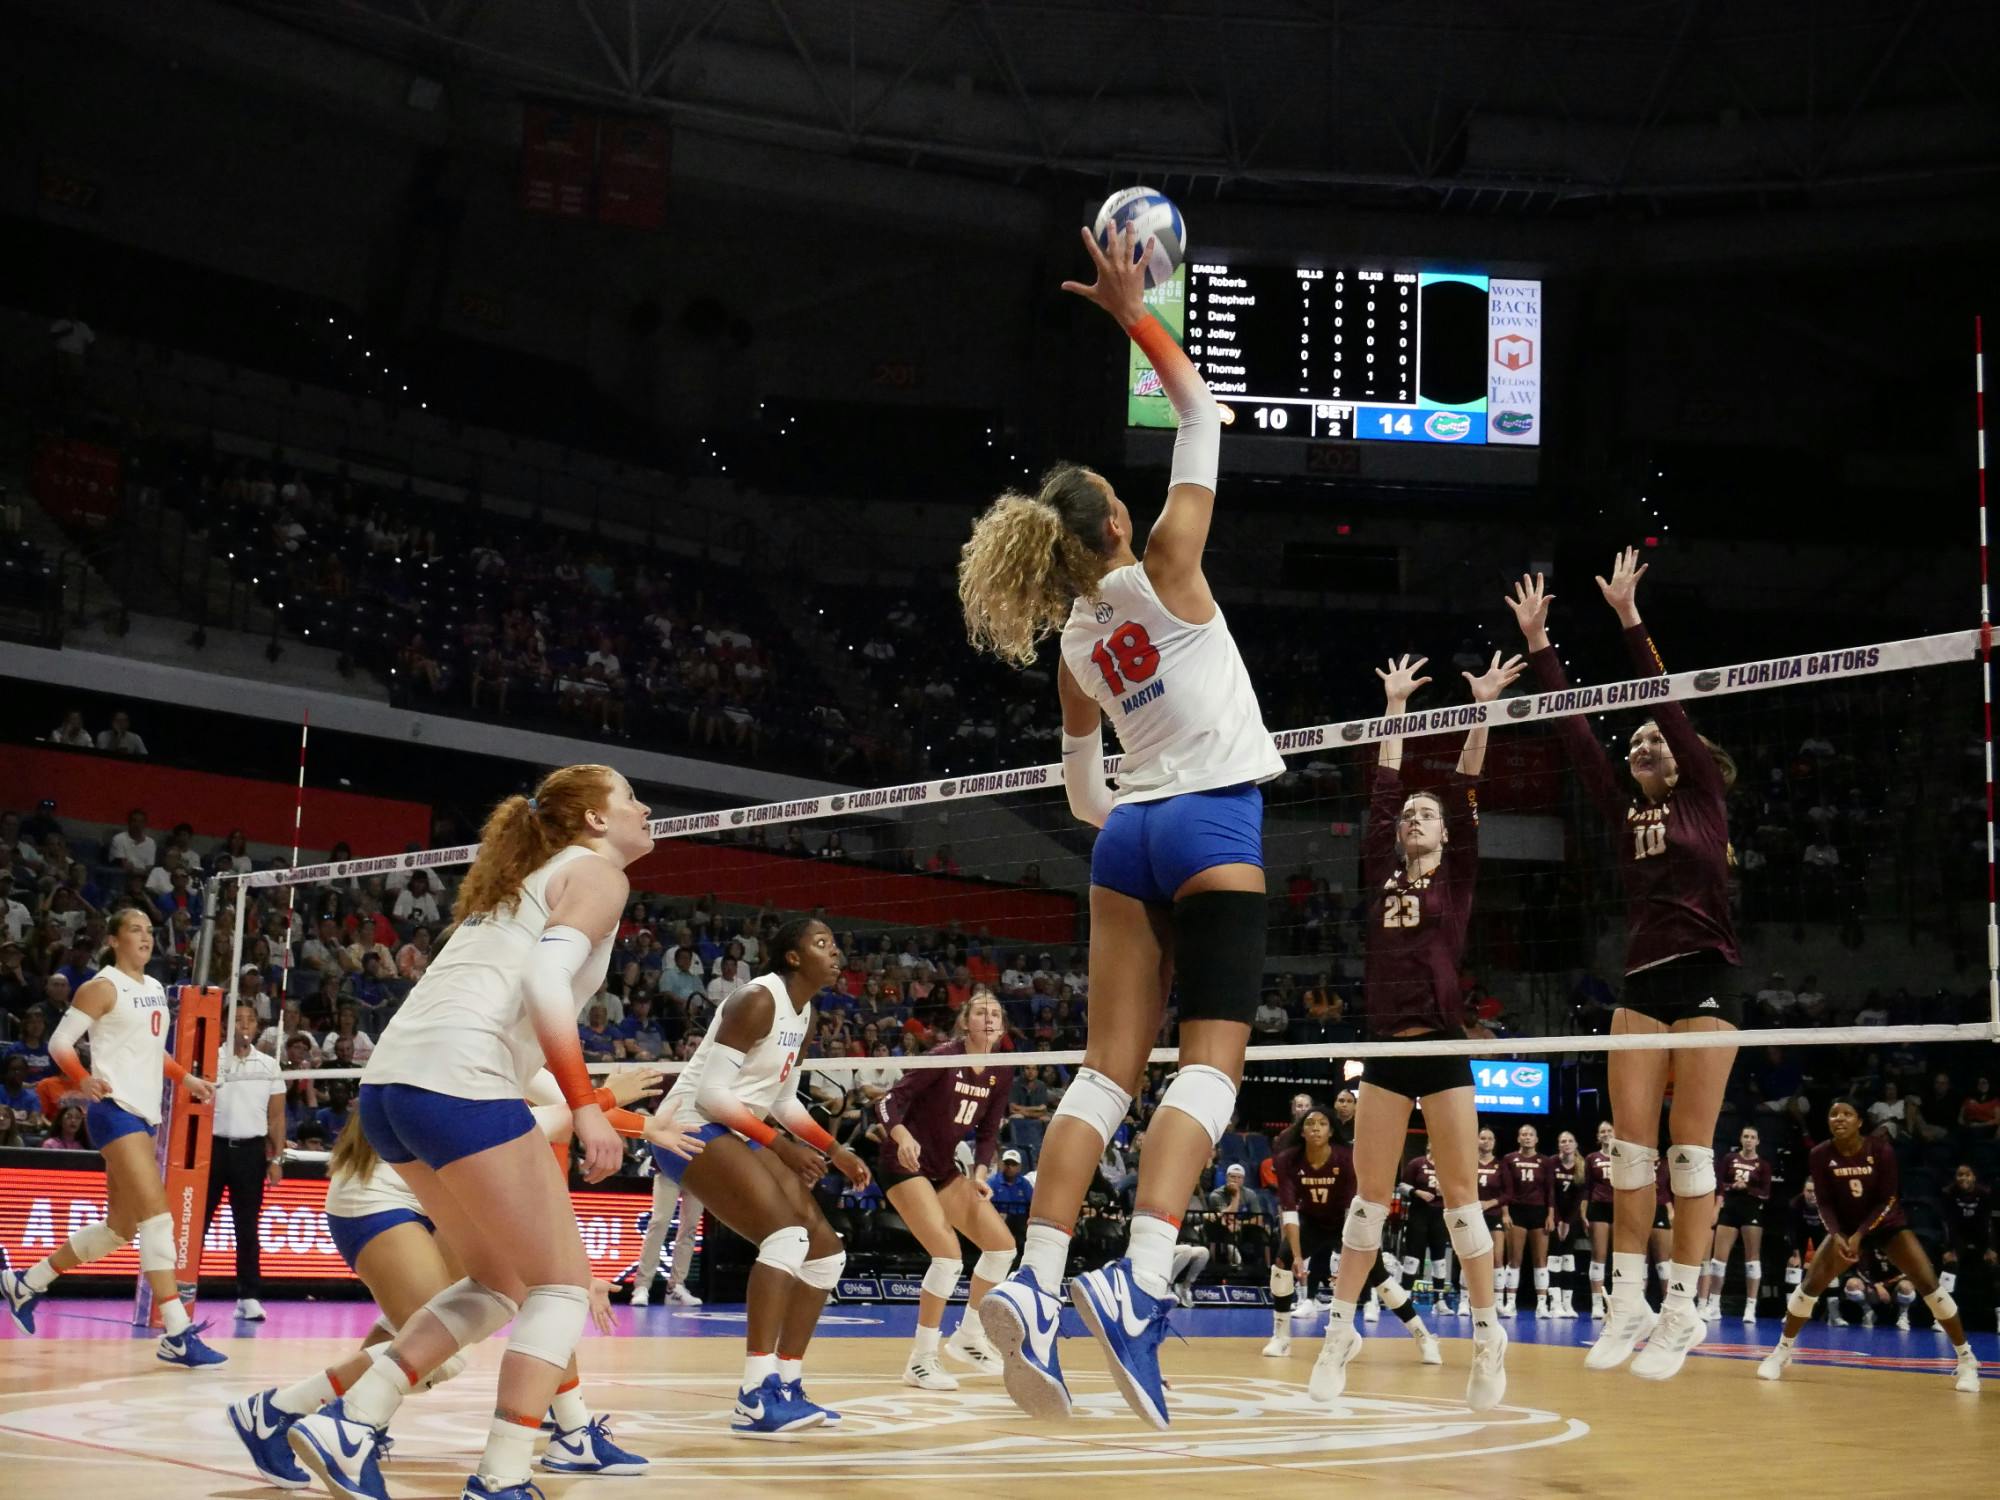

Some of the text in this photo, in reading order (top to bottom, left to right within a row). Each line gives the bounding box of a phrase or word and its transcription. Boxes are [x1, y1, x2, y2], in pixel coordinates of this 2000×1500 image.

[1192, 264, 1416, 284] EAGLES KILLS A BLKS DIGS
[1191, 275, 1197, 285] 1
[1208, 276, 1247, 288] Roberts
[1302, 281, 1310, 291] 0
[1335, 282, 1343, 292] 0
[1369, 284, 1375, 294] 1
[1400, 286, 1408, 295] 0
[1491, 286, 1537, 298] WON'T
[1143, 295, 1165, 304] AME
[1208, 294, 1255, 306] Shepherd
[1303, 298, 1309, 308] 1
[1335, 300, 1343, 310] 0
[1367, 301, 1375, 311] 0
[1400, 303, 1408, 313] 0
[1492, 299, 1537, 314] BACK
[1189, 310, 1407, 330] 9 Davis 1 0 0 3
[1491, 315, 1538, 328] DOWN!
[1189, 327, 1202, 338] 10
[1301, 333, 1309, 344] 3
[1334, 335, 1343, 345] 0
[1366, 336, 1375, 346] 0
[1399, 338, 1407, 347] 0
[1189, 344, 1407, 365] 16 Murray 0 3 0 0
[1206, 363, 1246, 375] Thomas
[1301, 367, 1308, 378] 1
[1333, 369, 1342, 379] 0
[1367, 371, 1374, 381] 1
[1400, 373, 1407, 383] 1
[1206, 381, 1246, 393] Cadavid
[1333, 387, 1341, 397] 2
[1399, 390, 1407, 401] 2
[1491, 387, 1535, 405] LAW
[1254, 407, 1288, 430] 10
[1316, 405, 1352, 420] SET
[1328, 421, 1341, 437] 2
[1378, 412, 1413, 436] 14
[1091, 620, 1161, 697] 18
[1727, 647, 1880, 688] FLORIDA GATORS
[1121, 679, 1164, 714] MARTIN
[1536, 677, 1670, 715] FLORIDA GATORS
[1368, 705, 1487, 738] FLORIDA GATORS
[959, 768, 1047, 794] FLORIDA GATORS
[847, 785, 927, 809] FLORIDA GATORS
[746, 799, 819, 822] FLORIDA GATORS
[653, 813, 720, 835] FLORIDA GATORS
[1633, 822, 1666, 860] 10
[415, 847, 469, 866] FLORIDA GATORS
[1383, 895, 1420, 928] 23
[133, 995, 167, 1008] FLORID
[151, 1010, 162, 1037] 0
[779, 1051, 795, 1083] 6
[1478, 1068, 1508, 1088] 14
[1531, 1095, 1540, 1107] 1
[954, 1099, 978, 1125] 18
[1520, 1168, 1535, 1182] 14
[1309, 1188, 1329, 1204] 17
[1562, 1181, 1572, 1193] 7
[1848, 1178, 1864, 1199] 9
[181, 1186, 194, 1223] sports
[21, 1197, 55, 1248] A
